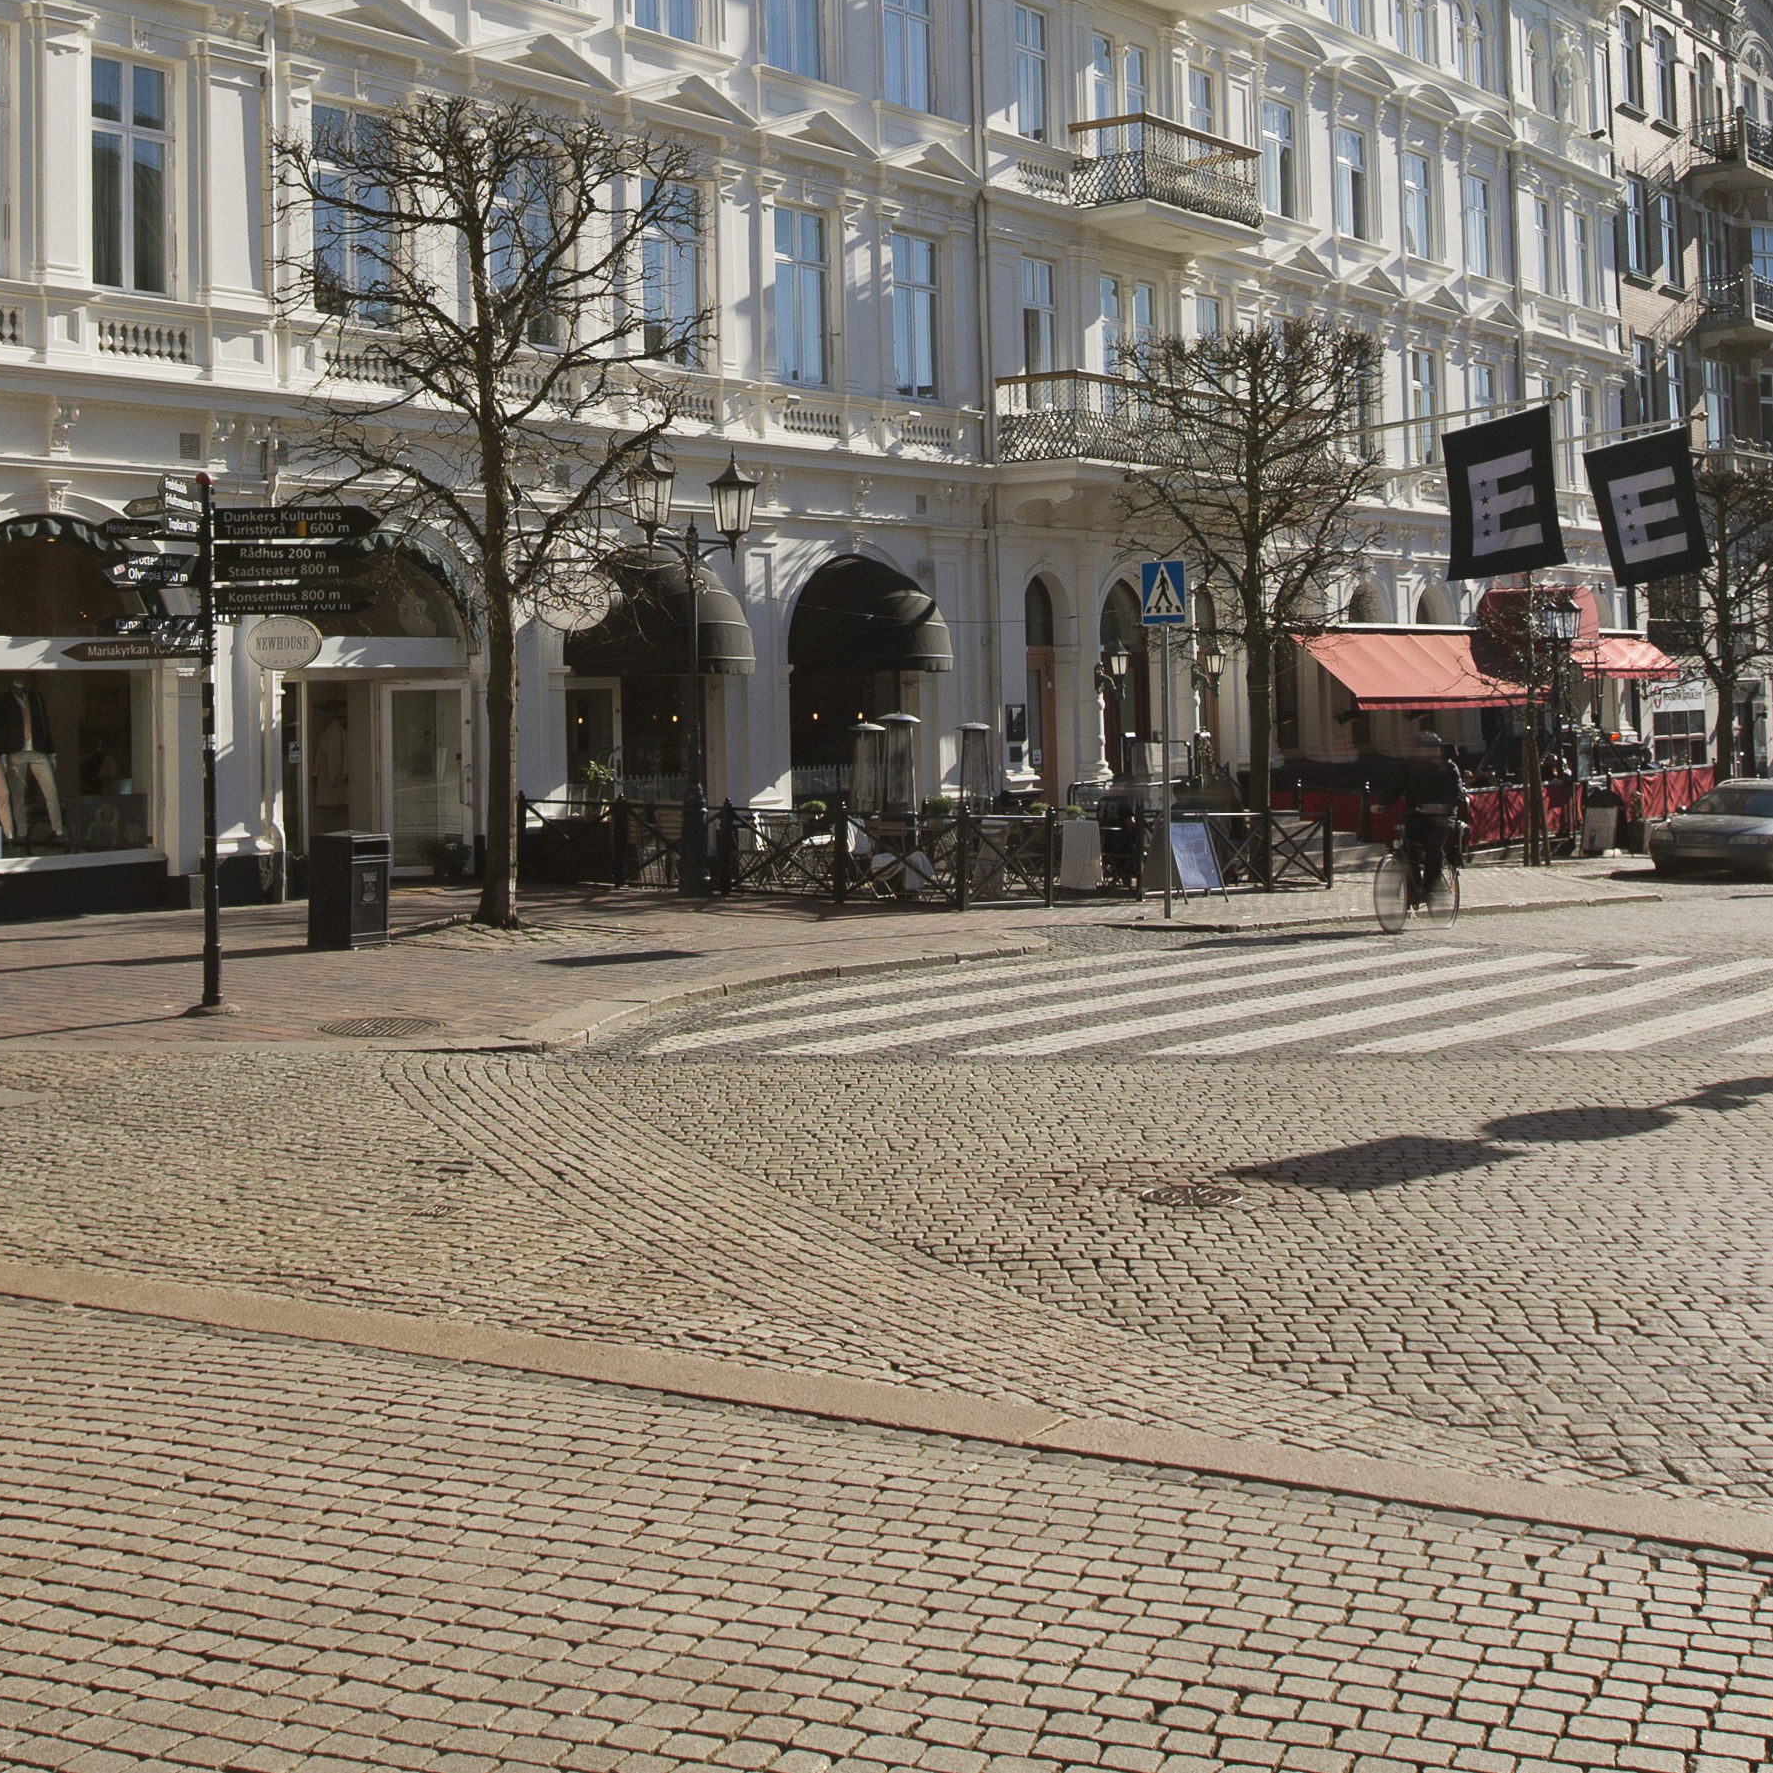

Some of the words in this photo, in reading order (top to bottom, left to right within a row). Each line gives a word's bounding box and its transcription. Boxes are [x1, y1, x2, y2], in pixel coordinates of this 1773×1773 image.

[223, 511, 276, 522] Dunkers
[280, 510, 342, 522] Kulturhus
[224, 523, 286, 537] Turistbyrå
[310, 523, 334, 533] 600
[338, 525, 350, 533] m
[128, 553, 164, 566] Idrottens
[165, 556, 181, 567] Hus
[240, 547, 284, 559] Rådhus
[288, 548, 312, 559] 200
[315, 551, 326, 559] m
[128, 568, 161, 582] Olympia
[180, 573, 189, 582] m
[228, 566, 296, 578] Stadsteater
[300, 564, 324, 574] 800
[328, 565, 340, 574] m
[228, 591, 297, 603] Konserthus
[301, 590, 325, 601] 800
[329, 592, 341, 601] m
[146, 618, 163, 630] 200
[87, 643, 150, 658] Mariakyrkan
[256, 636, 309, 651] NEWHOUSE
